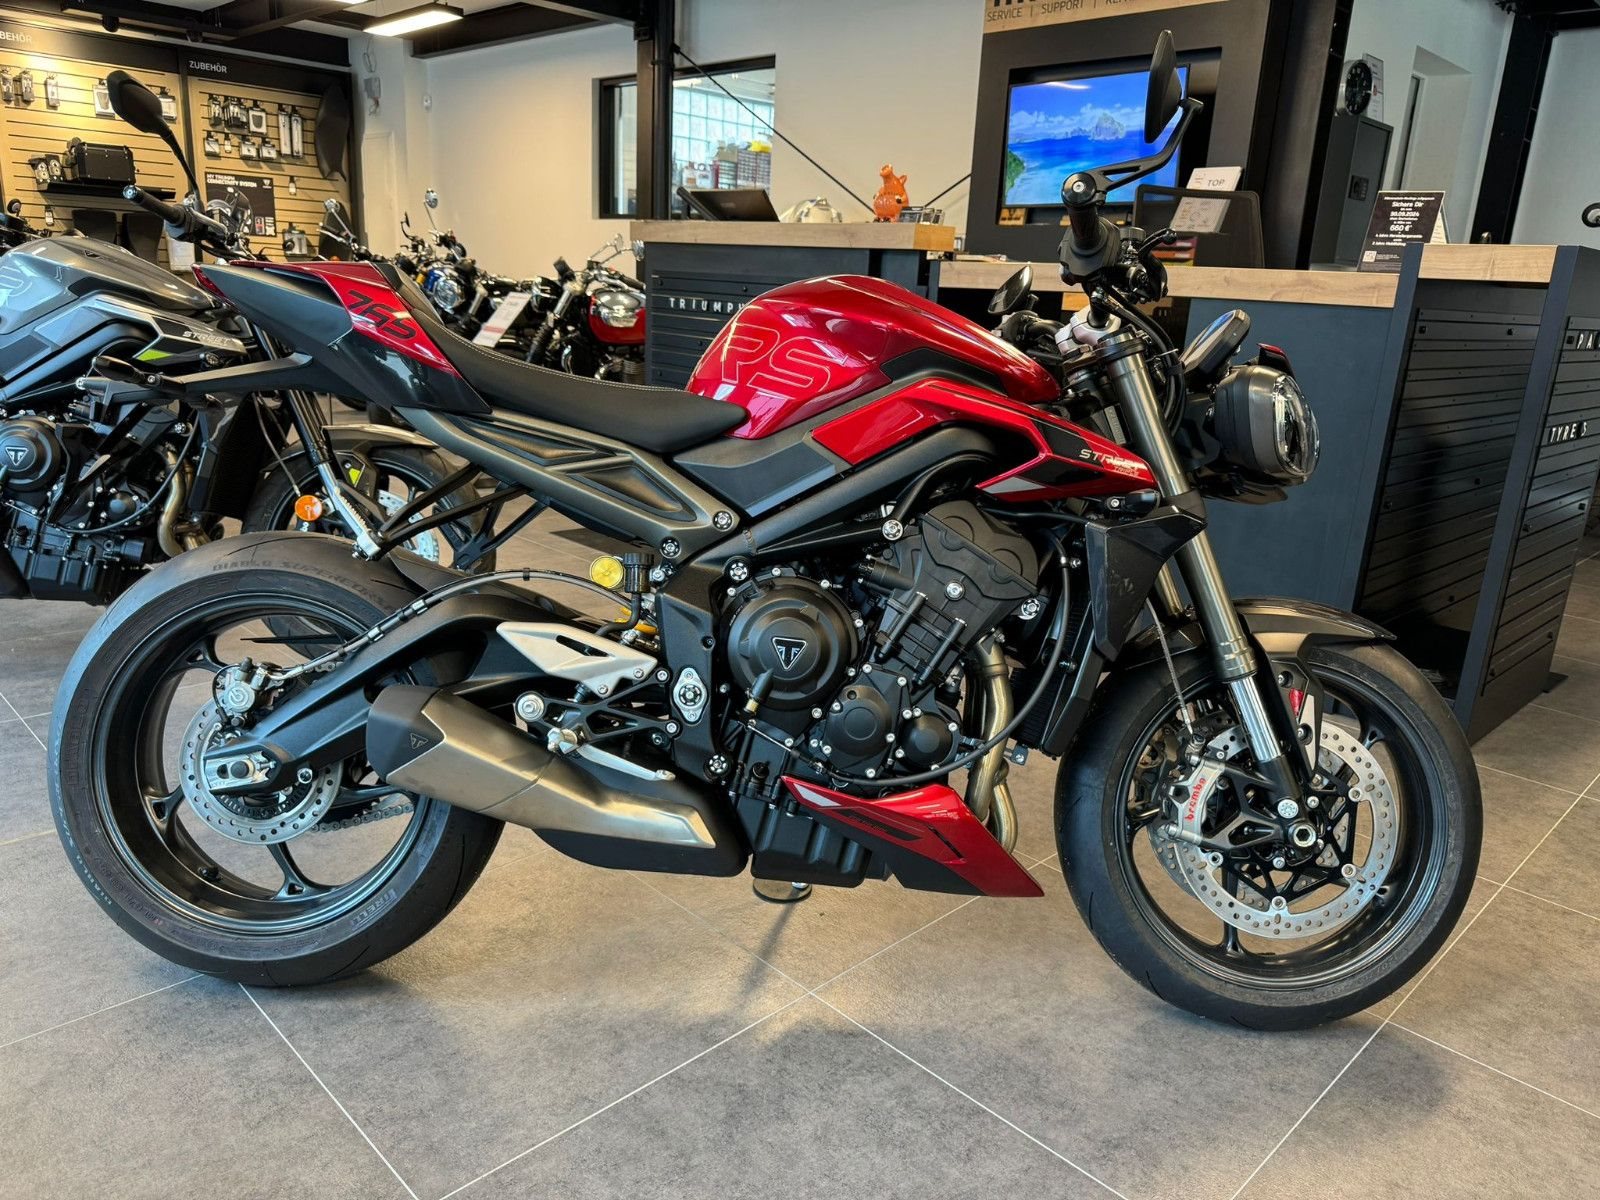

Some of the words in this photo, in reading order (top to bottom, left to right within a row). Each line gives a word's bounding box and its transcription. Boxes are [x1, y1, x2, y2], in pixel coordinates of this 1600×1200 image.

[987, 7, 1023, 22] SERVICE
[1041, 0, 1085, 15] SUPPORT
[189, 60, 228, 74] ZUBEHÖR
[1577, 333, 1600, 350] PA
[1184, 777, 1207, 821] brembo
